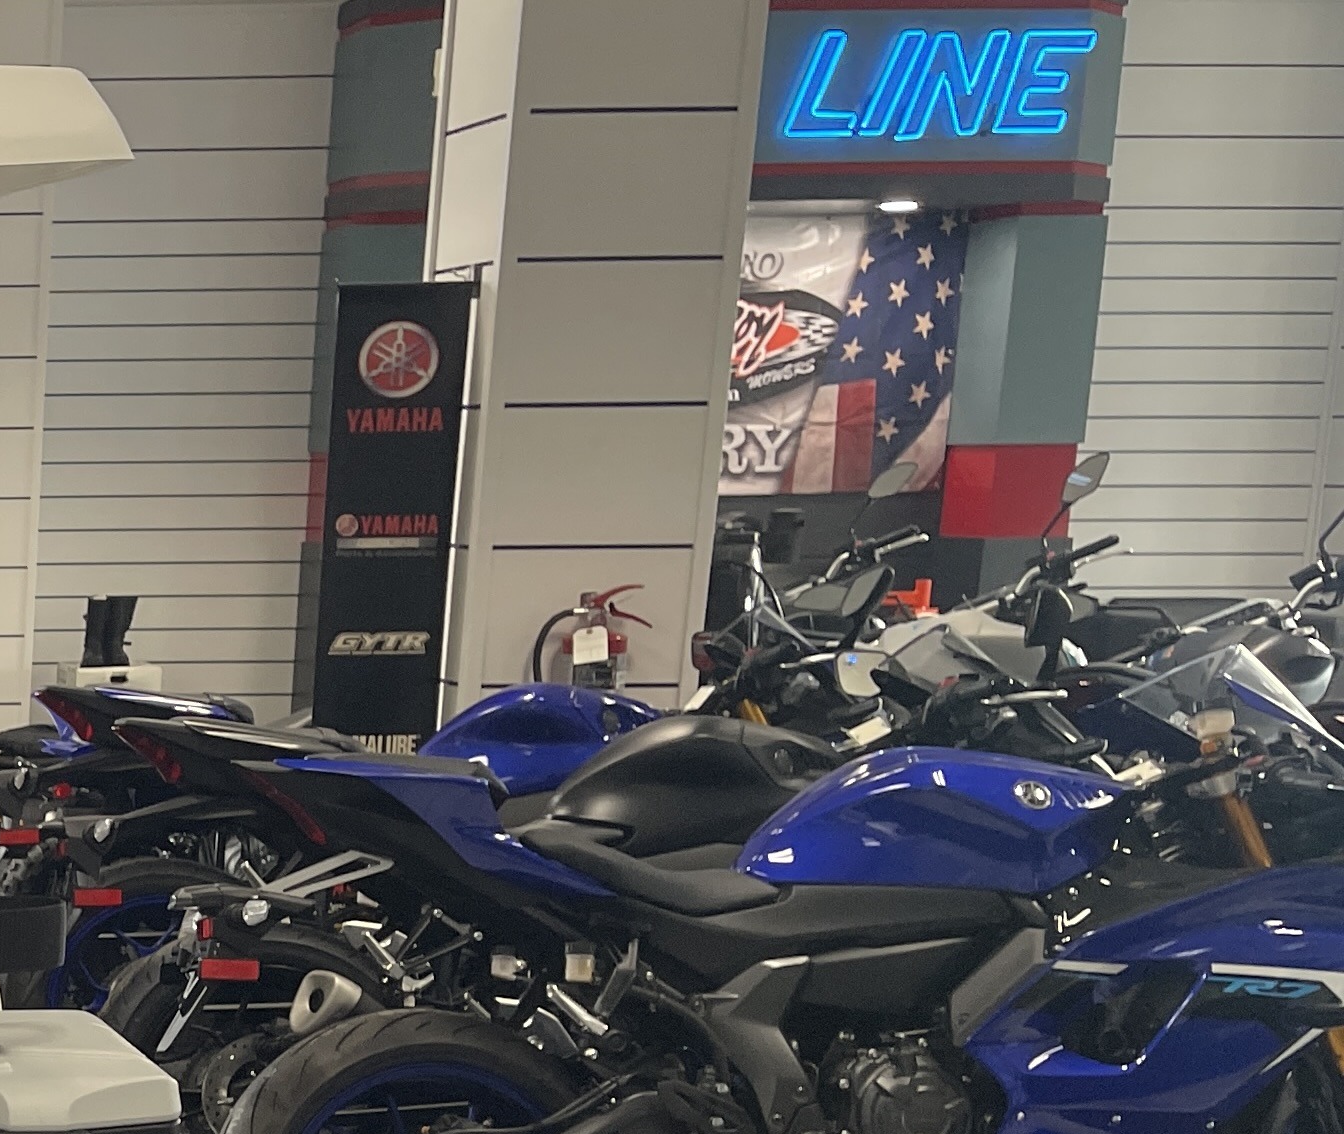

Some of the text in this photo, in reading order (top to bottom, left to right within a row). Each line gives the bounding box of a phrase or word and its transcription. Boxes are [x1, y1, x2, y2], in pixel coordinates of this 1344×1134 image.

[782, 28, 1098, 142] LINE
[347, 407, 444, 433] YAMAHA
[361, 514, 438, 535] YAMAHA
[329, 631, 430, 655] GYTR
